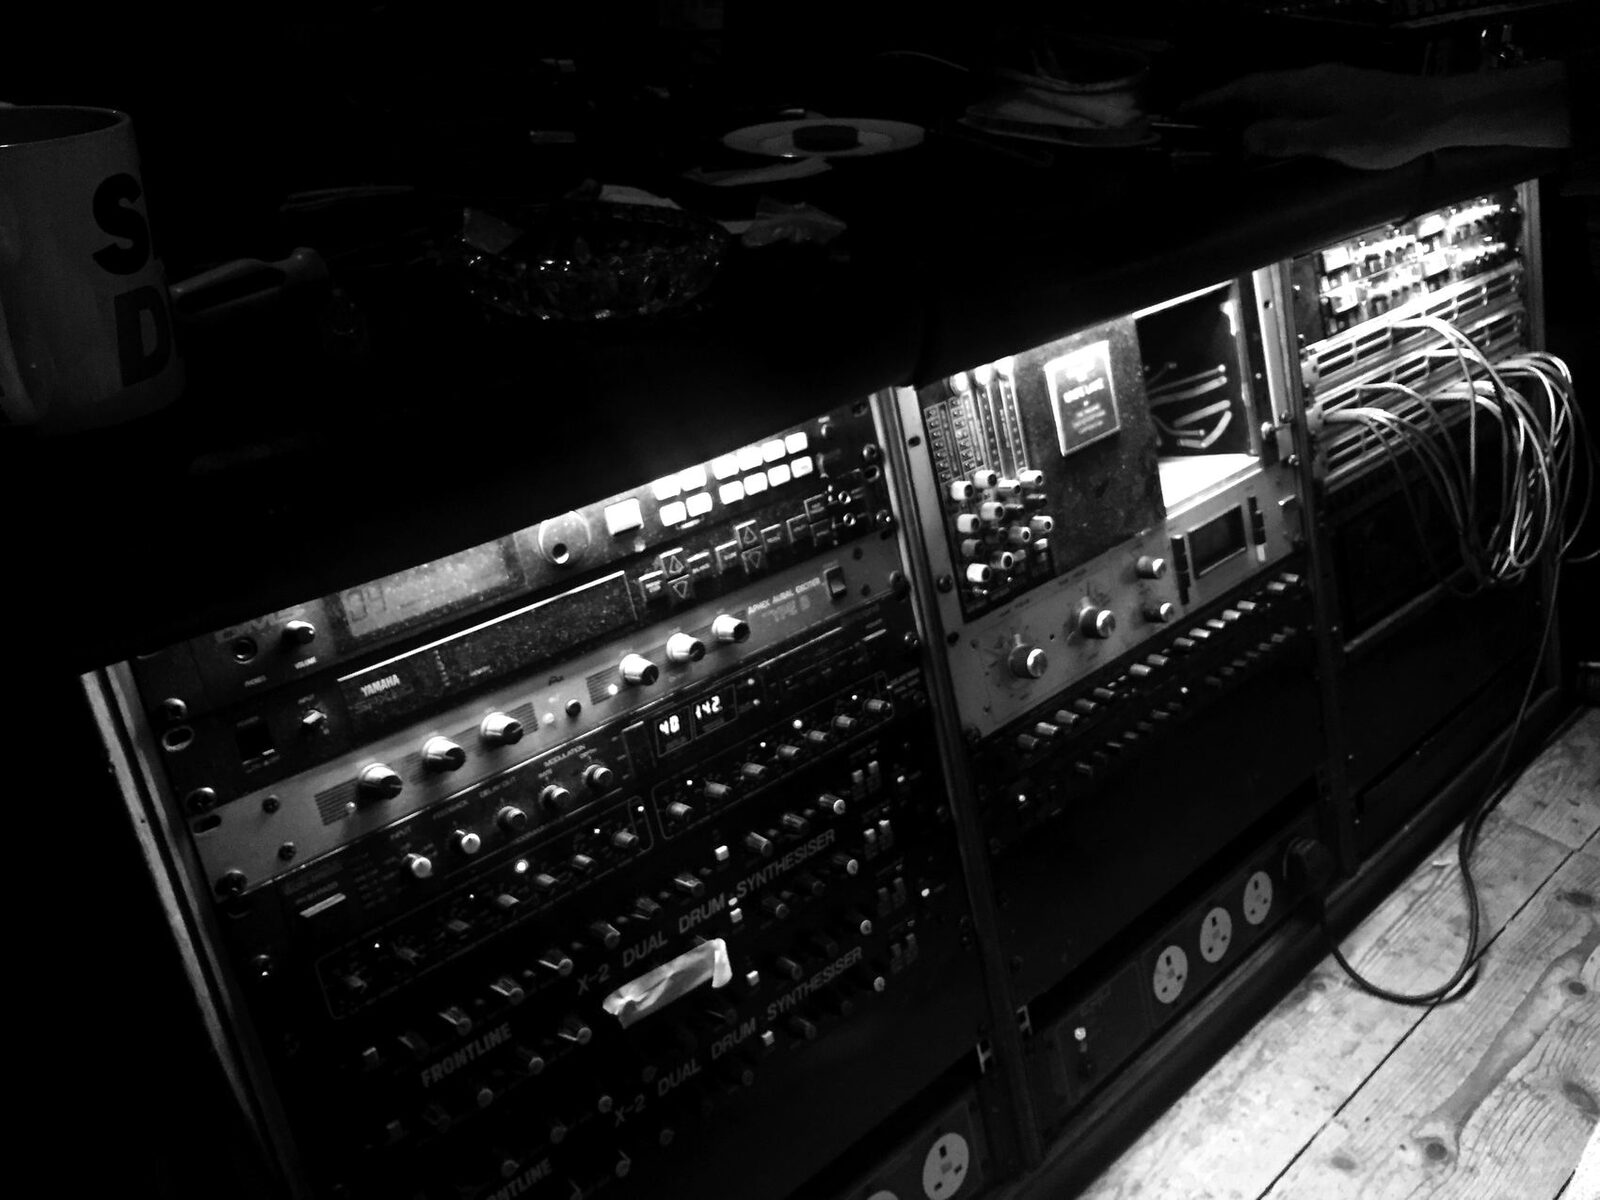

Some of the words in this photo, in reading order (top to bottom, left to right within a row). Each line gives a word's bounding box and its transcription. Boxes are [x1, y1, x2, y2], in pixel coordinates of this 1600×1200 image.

[93, 173, 149, 275] S
[114, 285, 171, 387] D
[360, 674, 401, 697] YAMAHA
[622, 931, 669, 968] DUAL
[678, 892, 725, 935] DRUM
[737, 828, 836, 899] SYNTHESISER
[420, 1021, 512, 1088] FRONTLINE
[656, 1057, 702, 1098] DUAL
[711, 1017, 757, 1060] DRUM
[766, 945, 864, 1022] SYNTHESISER
